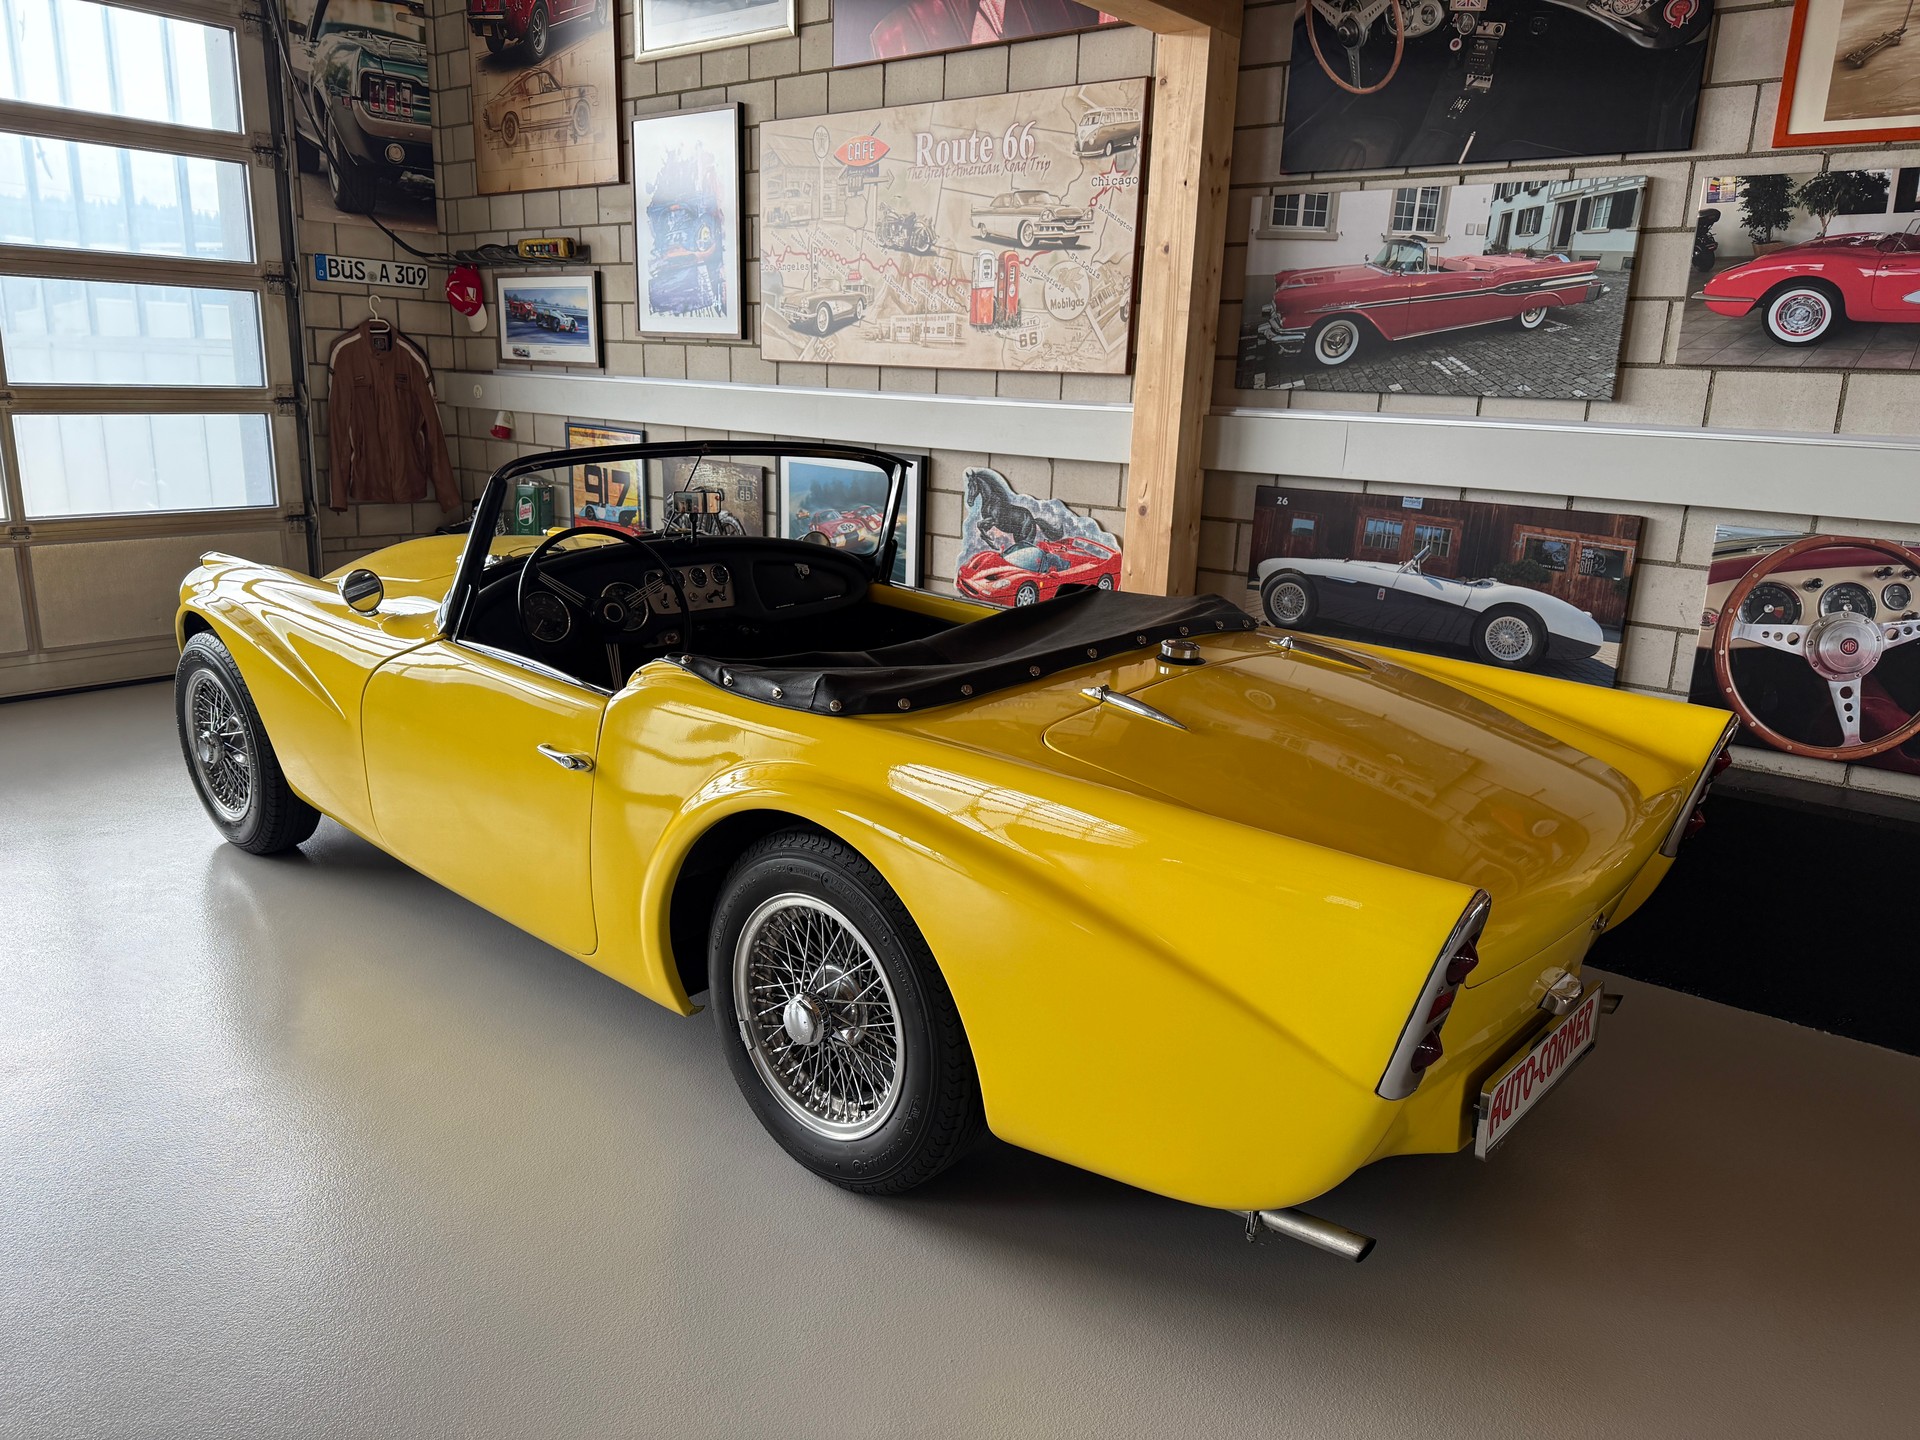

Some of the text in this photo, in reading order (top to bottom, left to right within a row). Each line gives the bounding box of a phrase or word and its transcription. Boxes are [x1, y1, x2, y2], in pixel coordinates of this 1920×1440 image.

[847, 141, 875, 161] CAFE
[914, 120, 1037, 168] Route 66
[906, 154, 1051, 186] The Great American Road Trip
[1091, 176, 1139, 187] Chicago
[1098, 203, 1133, 232] Bloomington
[328, 258, 365, 281] BÜS
[380, 264, 390, 283] A
[395, 265, 427, 286] 309
[760, 262, 809, 272] Los Angeles
[1081, 262, 1101, 279] Louis
[1032, 265, 1064, 292] Springfield
[883, 275, 917, 305] Albuquerque
[936, 290, 958, 310] Amarillo
[1050, 297, 1085, 310] Mobilgas
[1019, 331, 1038, 348] 66
[584, 465, 630, 507] 917
[1277, 497, 1289, 506] 26
[1843, 640, 1857, 653] MG
[1489, 998, 1595, 1140] AUTO-CORNER
